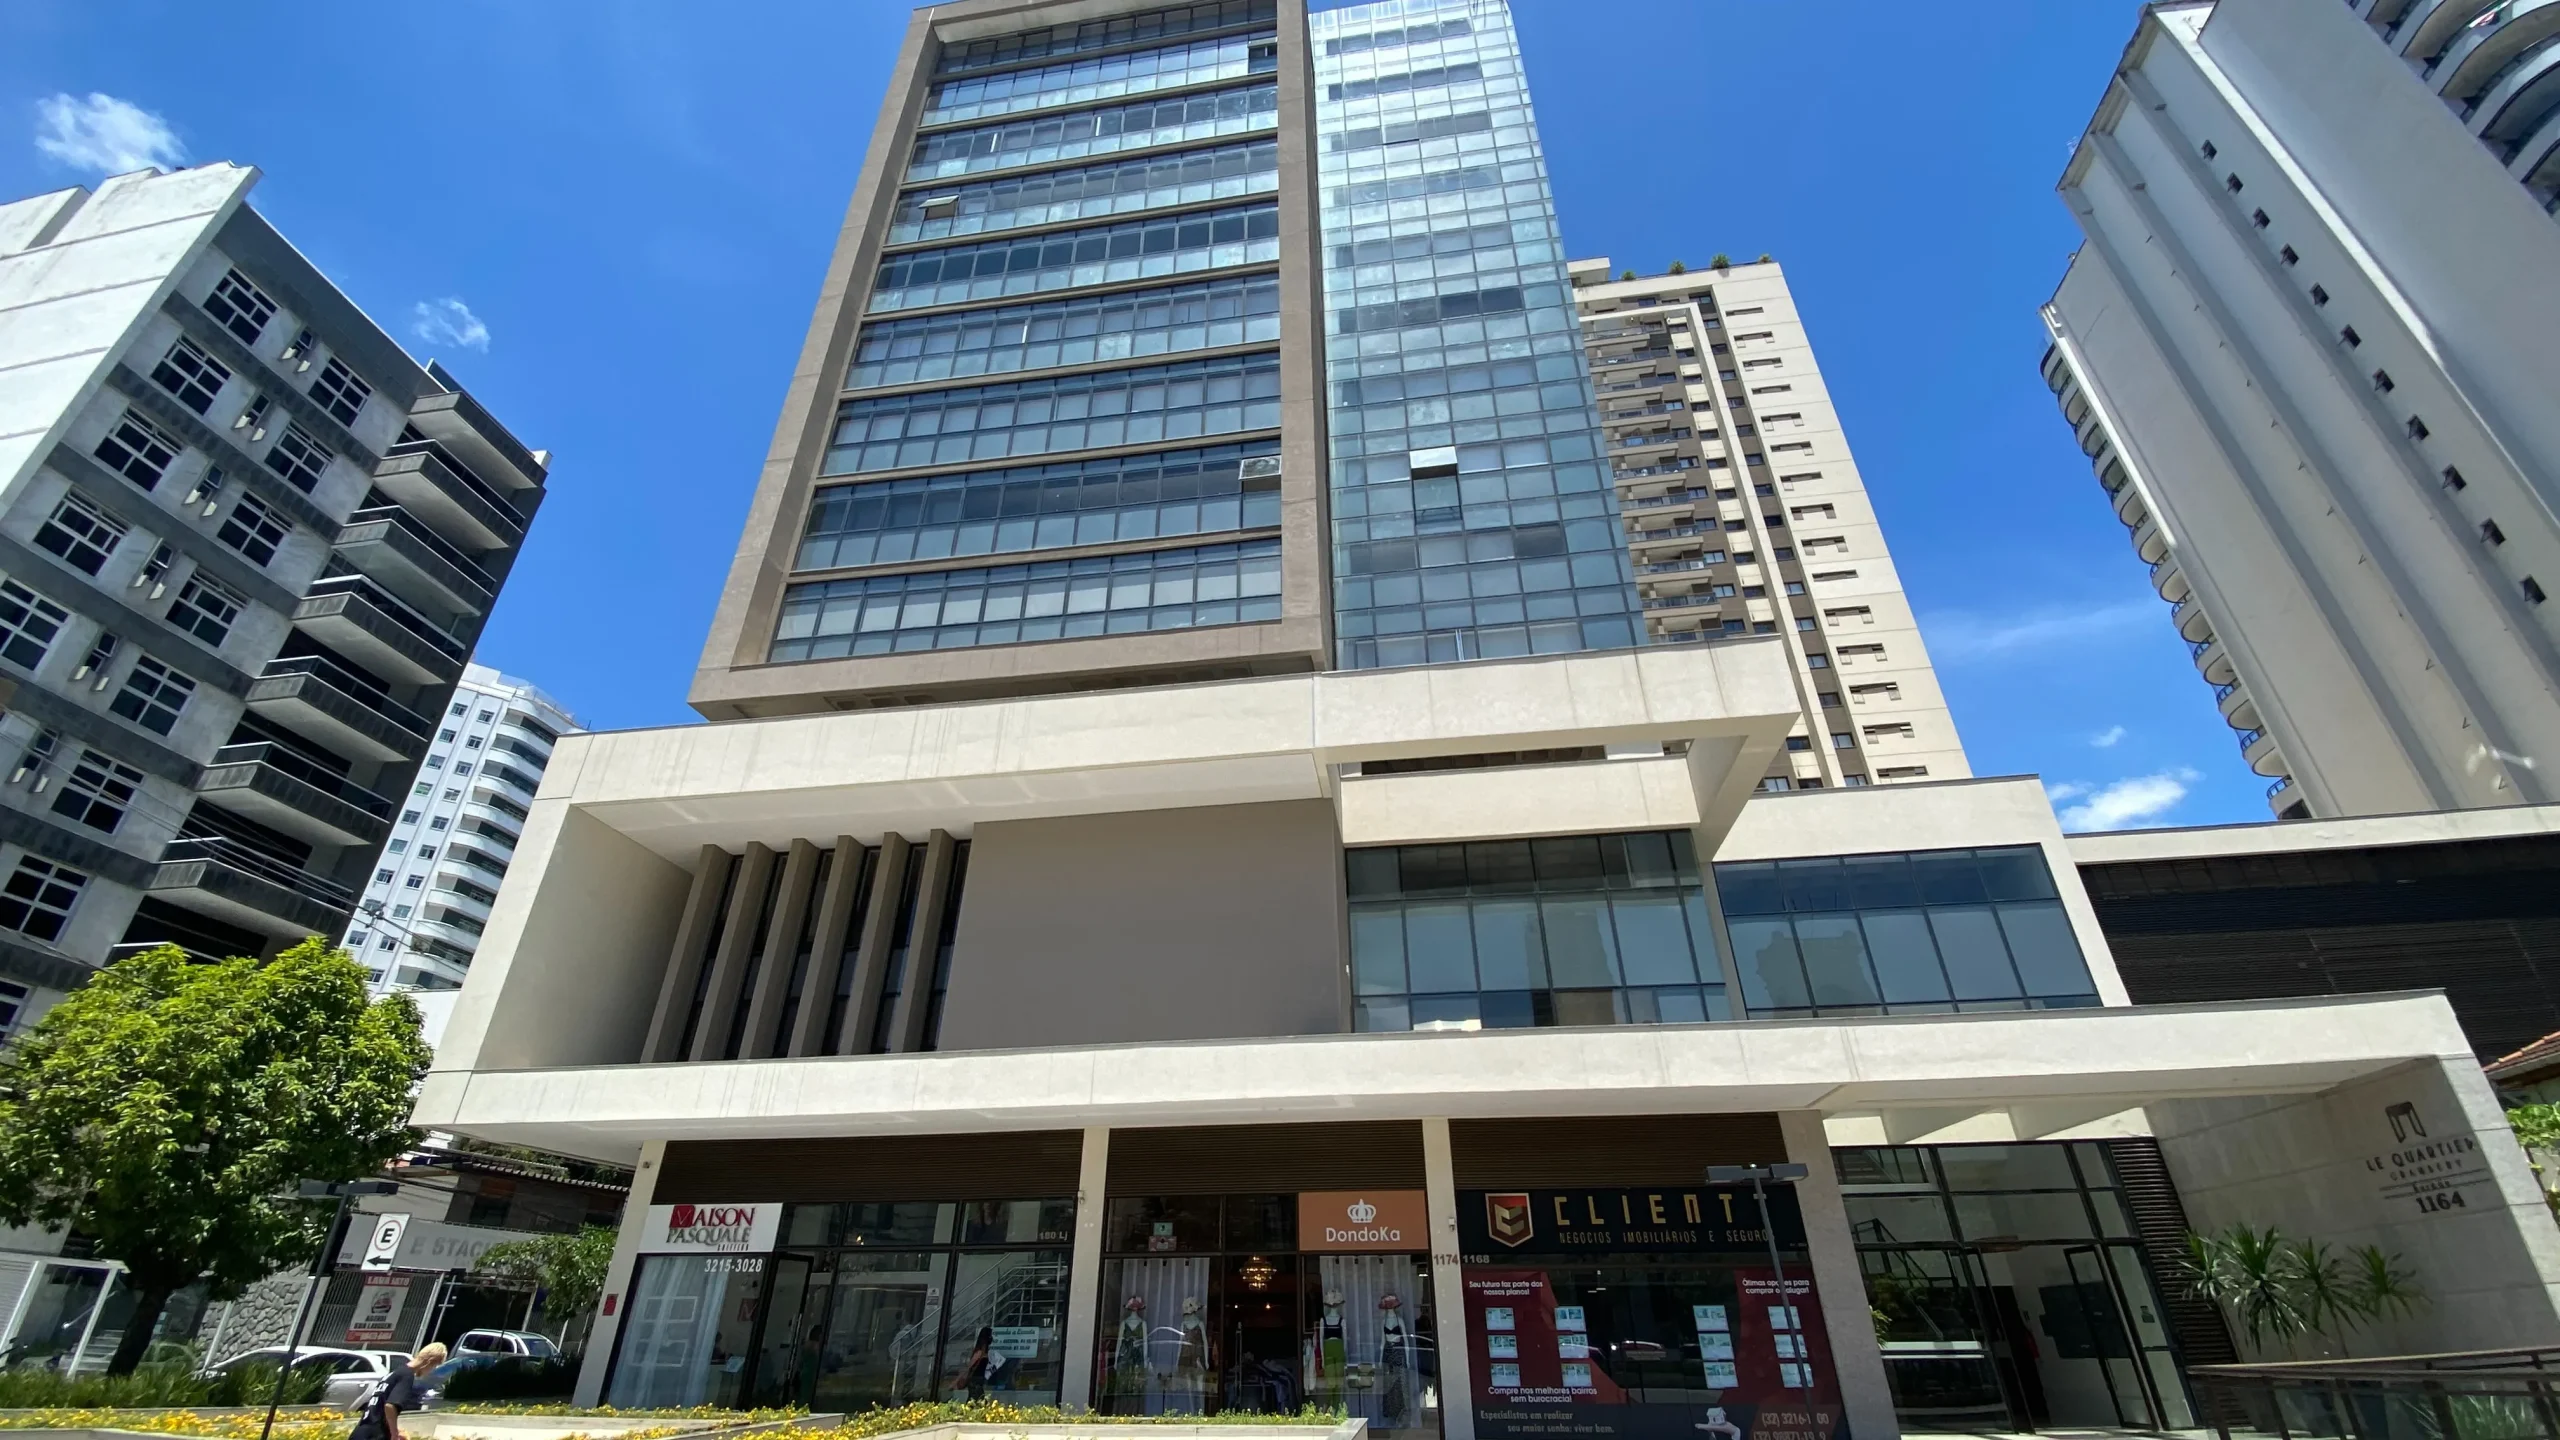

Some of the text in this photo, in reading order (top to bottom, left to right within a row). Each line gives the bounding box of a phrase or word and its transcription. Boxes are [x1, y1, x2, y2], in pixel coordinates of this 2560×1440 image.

[2366, 1157, 2385, 1172] LE
[2416, 1191, 2466, 1213] 1164
[1554, 1193, 1766, 1225] CLIENT
[381, 1228, 395, 1243] E
[666, 1227, 752, 1246] PASQUALE
[1326, 1226, 1401, 1242] DondoKa
[1709, 1230, 1715, 1243] E
[1726, 1229, 1772, 1242] SEGURO
[1434, 1254, 1458, 1265] 1174
[1463, 1255, 1490, 1264] 1168
[1512, 1281, 1530, 1289] parte
[1767, 1279, 1792, 1288] opçes
[1793, 1280, 1810, 1288] para
[1746, 1287, 1774, 1295] comprar
[1488, 1387, 1519, 1396] Compre
[1535, 1386, 1570, 1395] melhores
[1571, 1386, 1597, 1395] bairros
[1480, 1410, 1573, 1421] Especialistas em realizar
[1762, 1412, 1829, 1427] (32) 3216-100
[1507, 1424, 1520, 1432] seu
[1522, 1423, 1545, 1433] maior
[1574, 1424, 1594, 1433] viver
